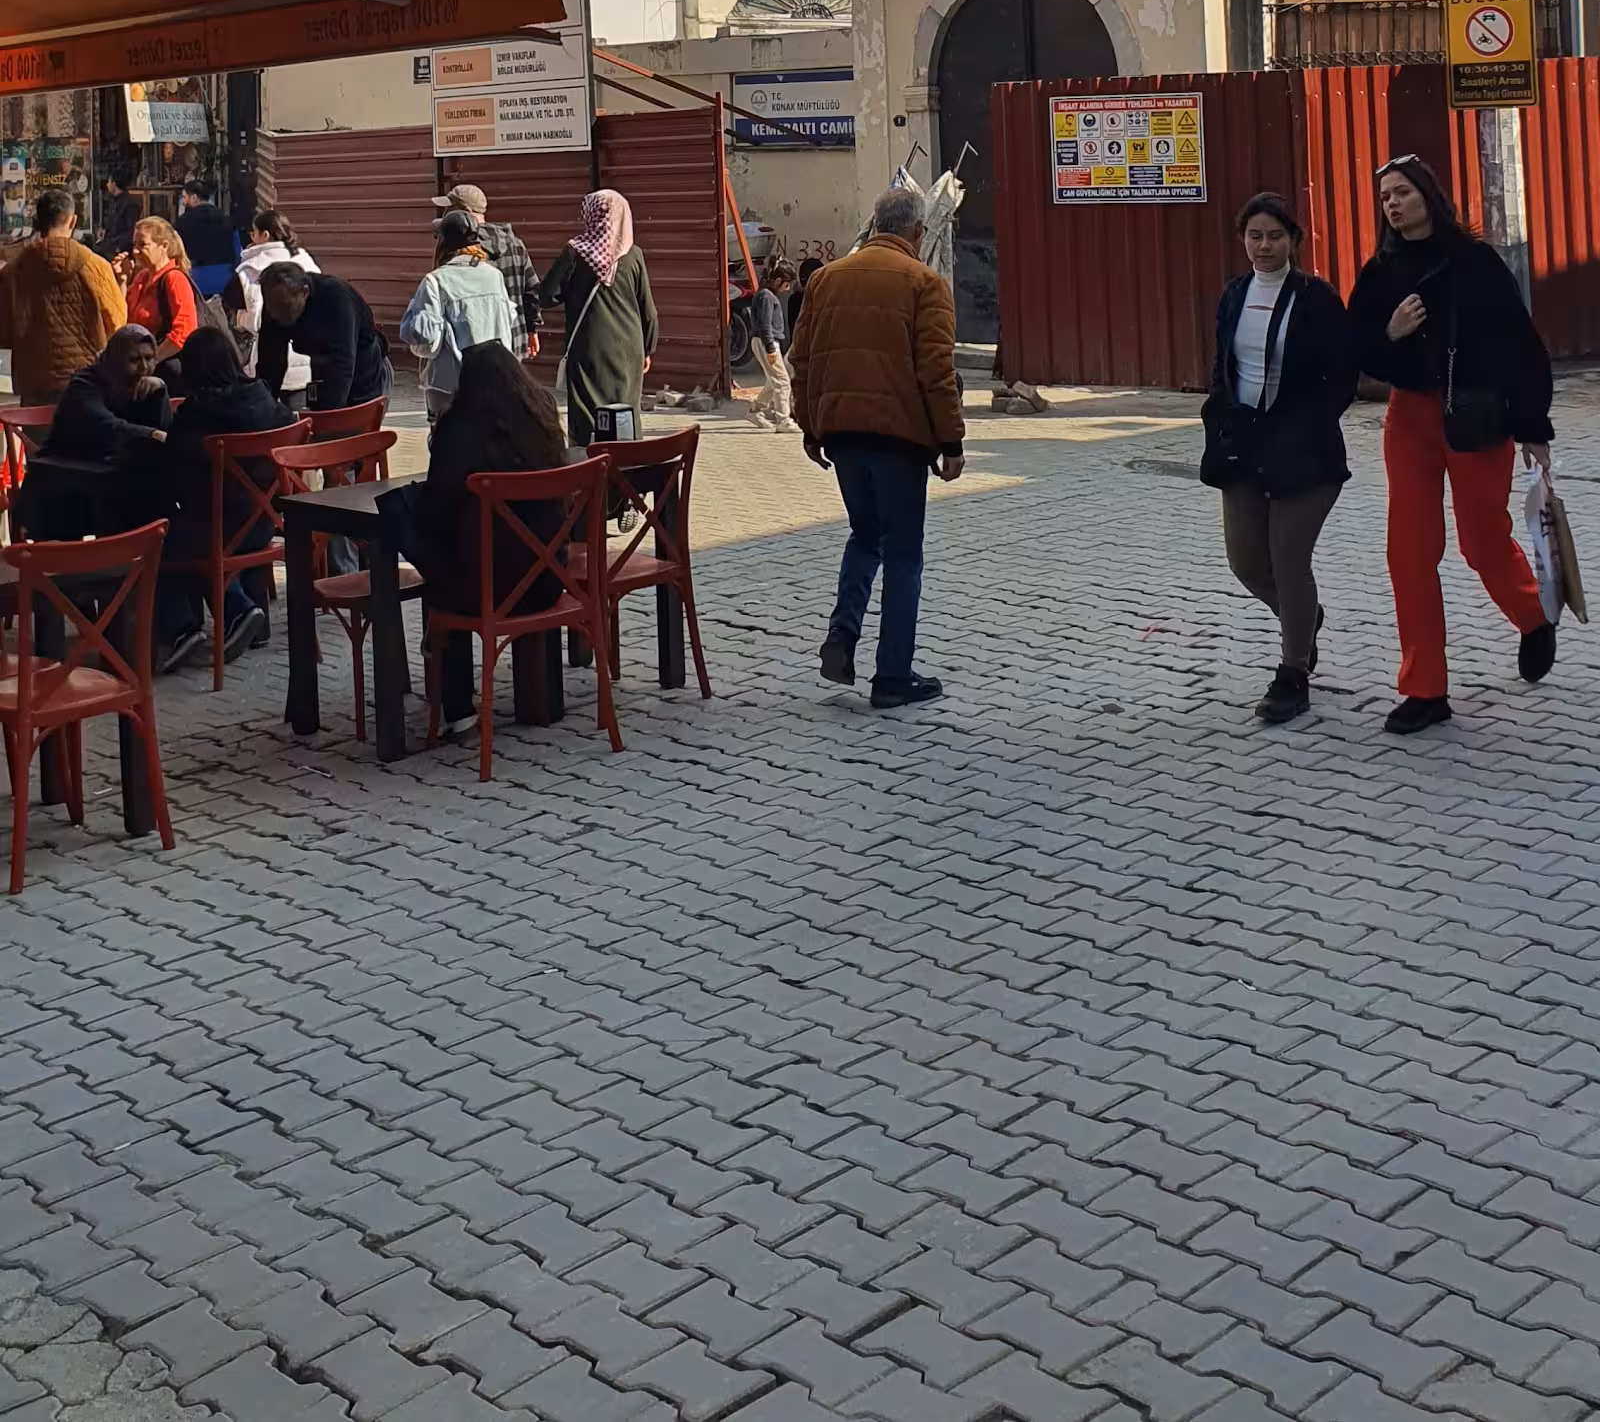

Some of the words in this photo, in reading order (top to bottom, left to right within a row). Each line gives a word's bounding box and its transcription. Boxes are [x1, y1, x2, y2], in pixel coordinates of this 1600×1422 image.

[511, 50, 537, 61] VAKIFLAR
[497, 63, 514, 76] BÖLGE
[514, 60, 547, 74] MÜDÜRLÜĞÜ
[1459, 63, 1526, 74] 10:30-19:30
[1460, 76, 1497, 87] Saatleri
[530, 95, 568, 106] RESTORASYON
[771, 92, 784, 102] T.C.
[771, 101, 796, 112] KONAK
[796, 98, 840, 111] MÜFTÜLÜĞÜ
[136, 109, 169, 121] Oranik
[172, 112, 181, 120] ve
[535, 109, 543, 119] VE
[820, 118, 855, 135] CAMİ
[1062, 189, 1075, 197] CAN
[1171, 187, 1197, 196] UYUNUZ
[796, 240, 836, 262] 338
